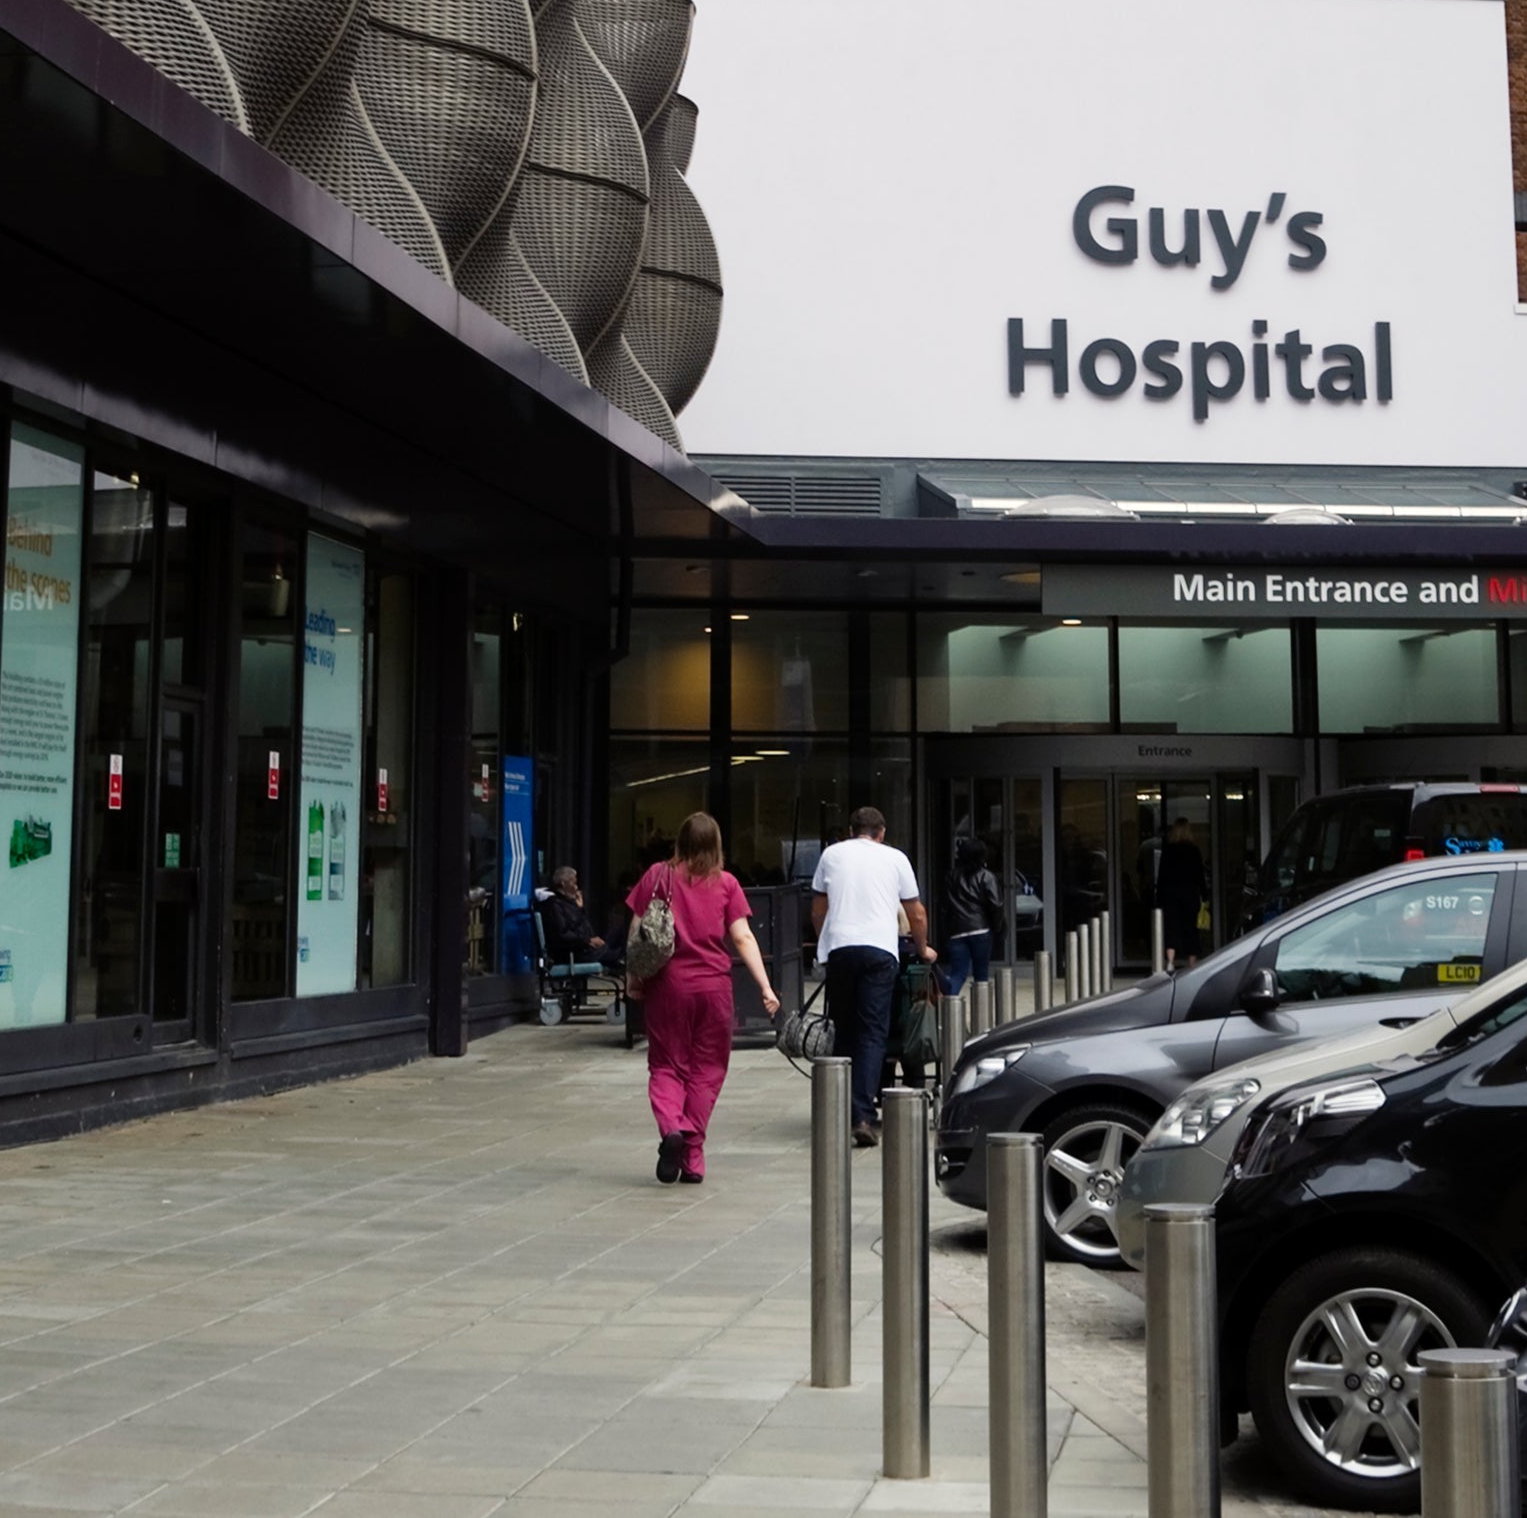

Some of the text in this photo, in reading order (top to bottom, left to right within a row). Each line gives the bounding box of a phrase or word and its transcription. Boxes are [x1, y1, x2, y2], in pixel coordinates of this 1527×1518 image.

[1073, 185, 1327, 290] Guy's
[1007, 317, 1393, 421] Hospital
[1172, 574, 1255, 603] Main
[1266, 574, 1408, 604] Entrance
[1419, 574, 1478, 604] and
[1137, 745, 1192, 757] Entrance
[1426, 896, 1459, 909] S167
